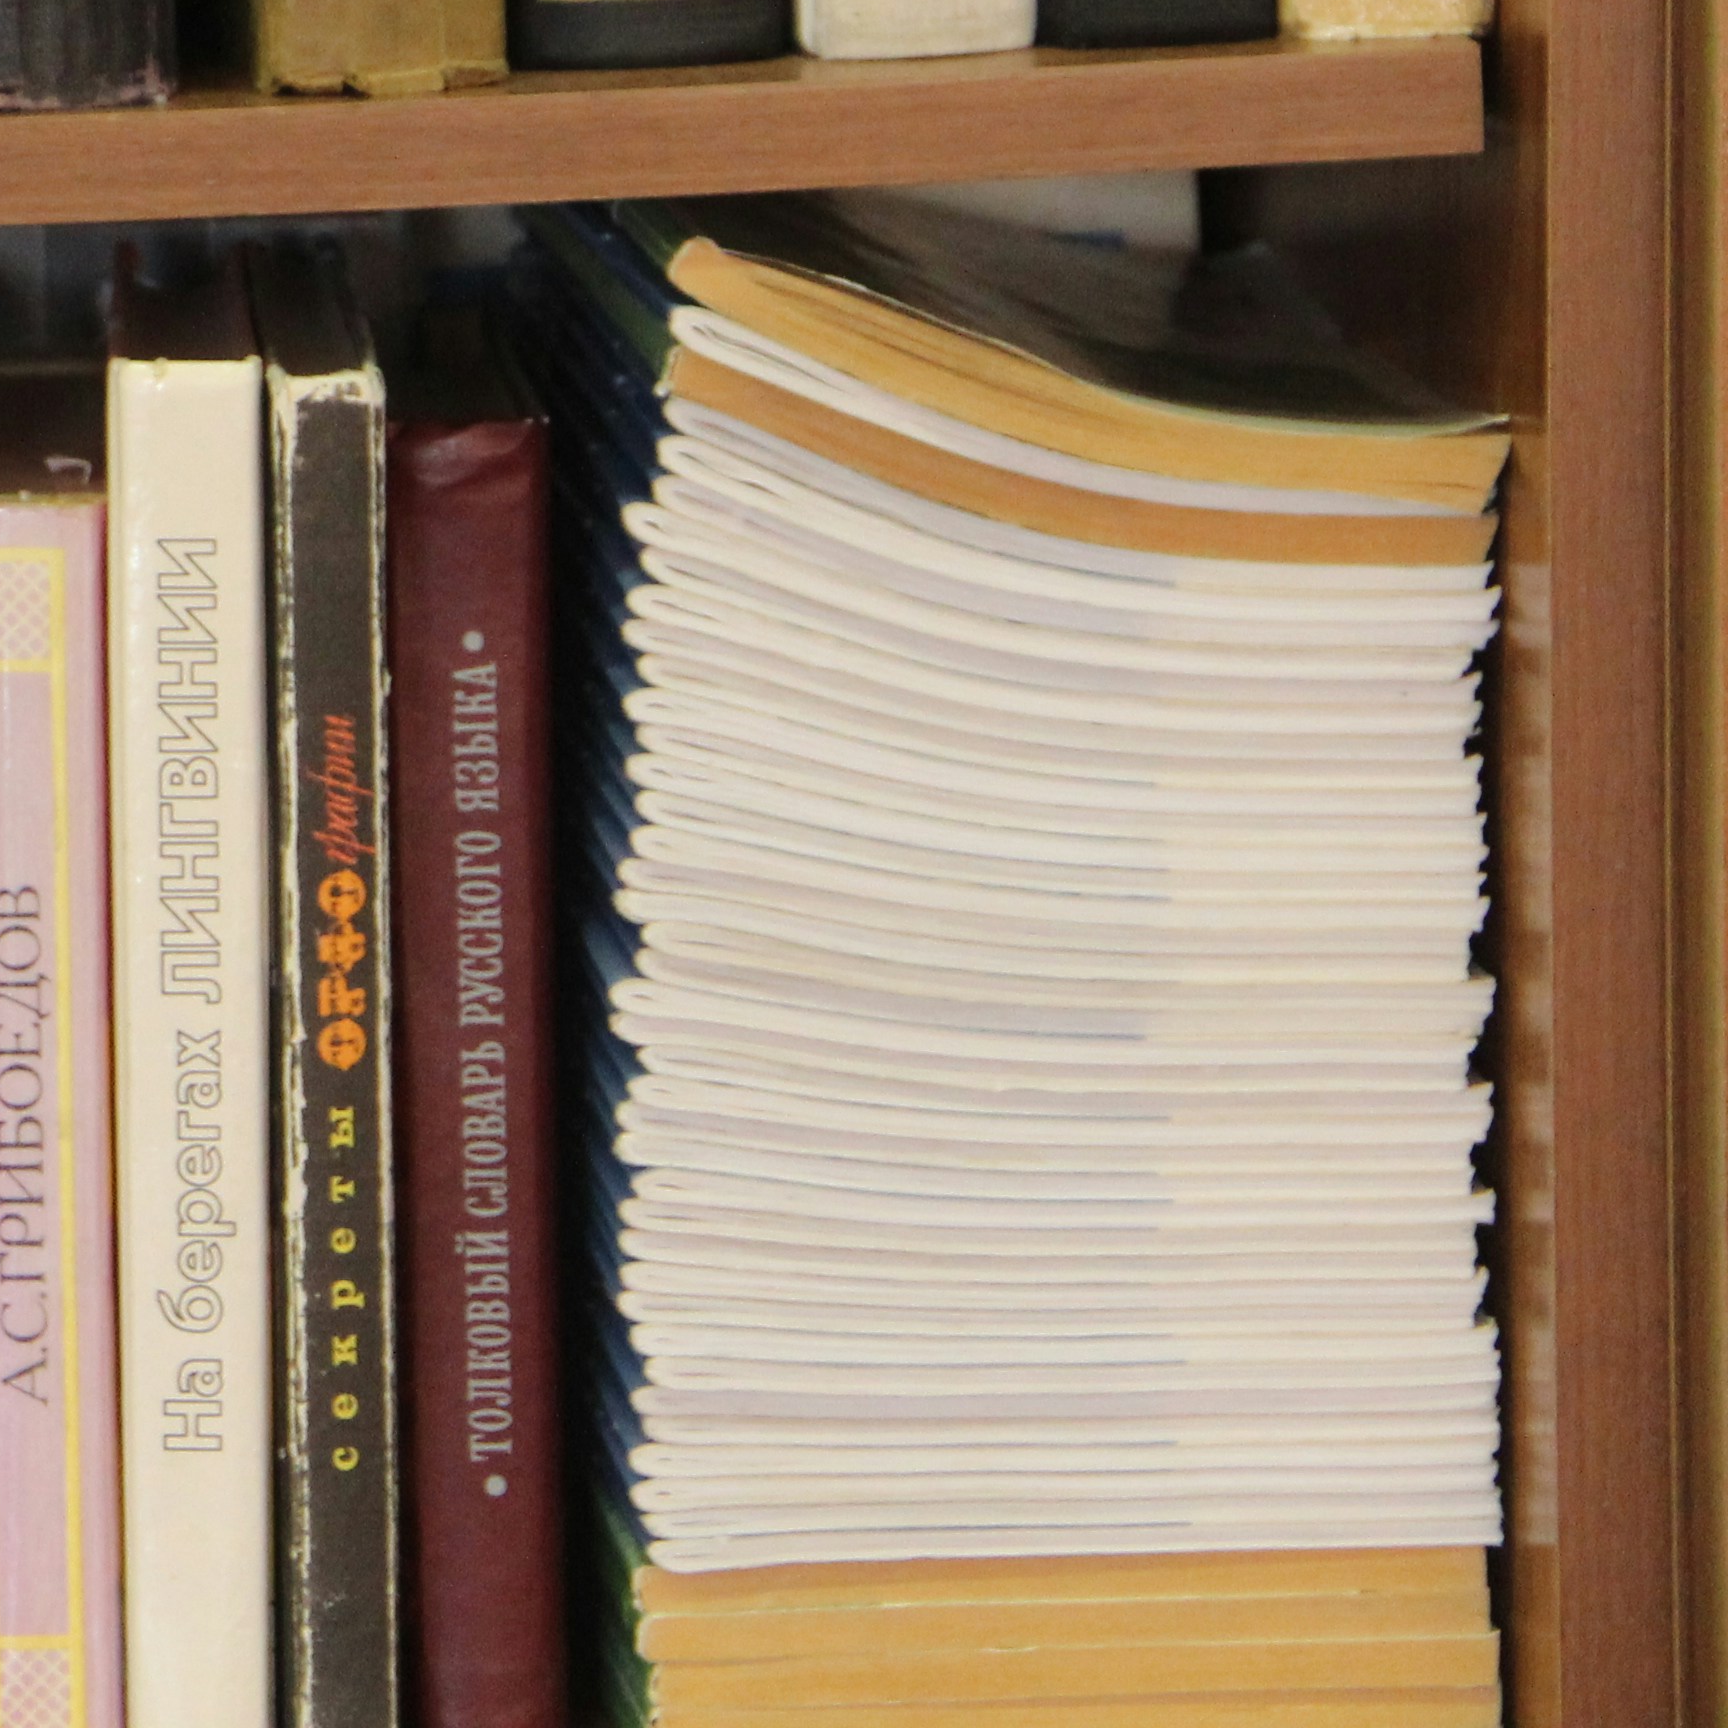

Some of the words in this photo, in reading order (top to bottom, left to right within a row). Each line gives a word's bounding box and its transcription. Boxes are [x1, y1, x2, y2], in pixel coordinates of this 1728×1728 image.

[156, 536, 222, 1005] ЛИНГВИНИИ
[451, 661, 500, 813] ЯЗЫКА
[453, 830, 507, 1028] РУССКОГО
[156, 1029, 237, 1334] берегах
[458, 1039, 510, 1219] СЛОВАРЬ
[327, 1105, 365, 1472] секреты
[453, 1228, 514, 1463] ТОЛКОВЫЙ
[162, 1357, 223, 1453] На
